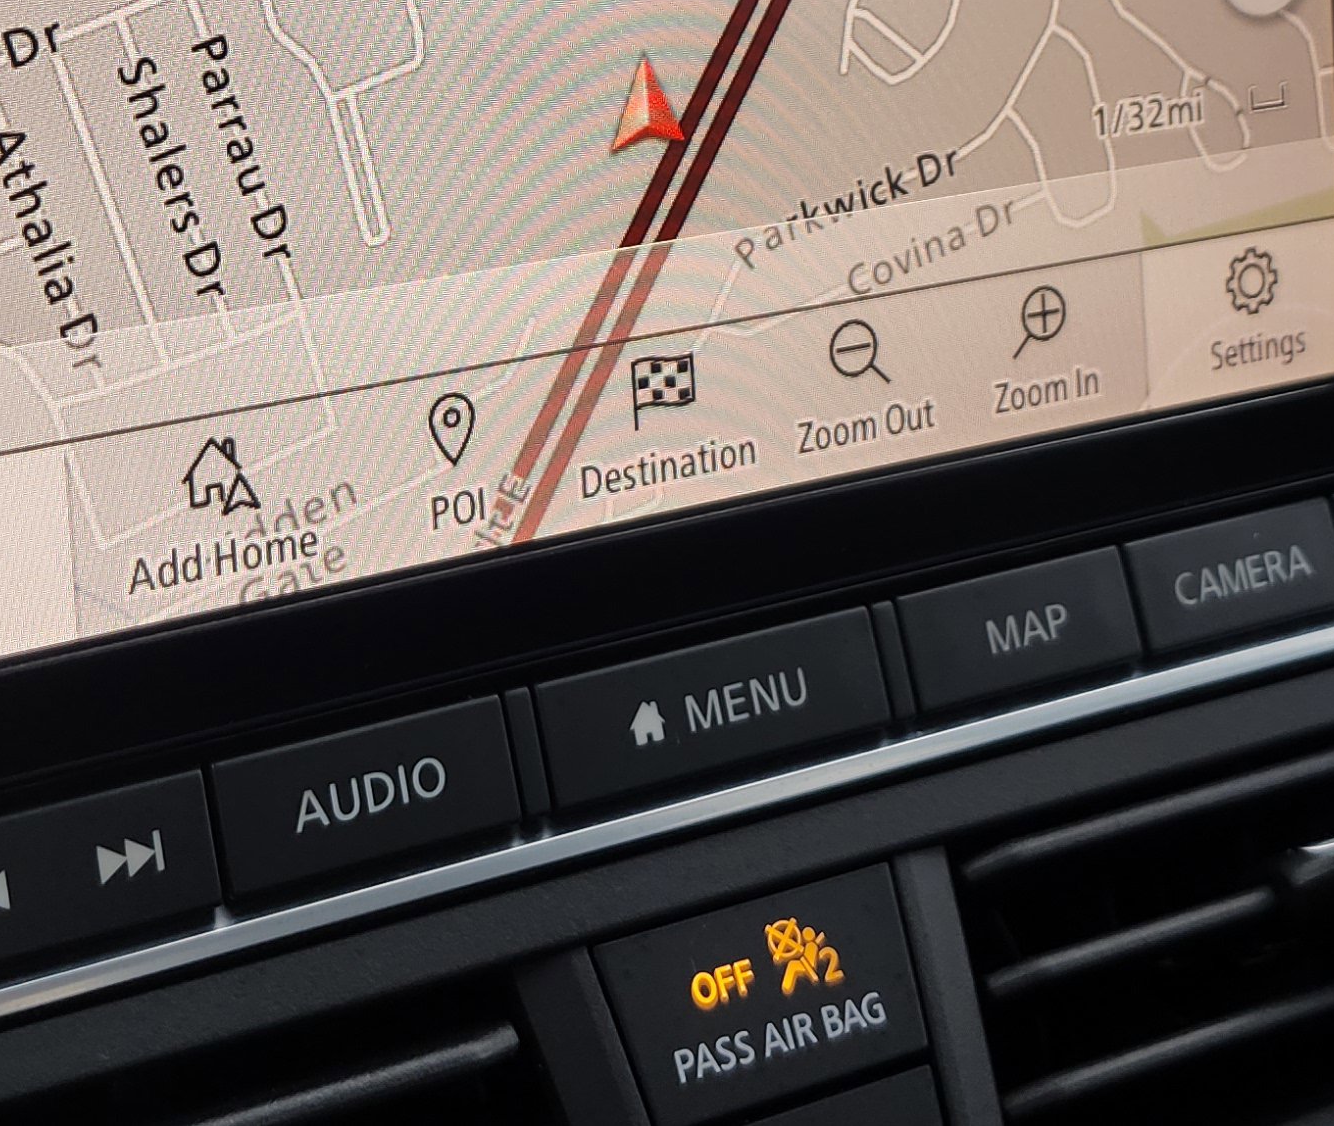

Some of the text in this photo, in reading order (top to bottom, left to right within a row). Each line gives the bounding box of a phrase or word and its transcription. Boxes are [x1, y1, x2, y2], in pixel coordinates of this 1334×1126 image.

[3, 22, 61, 68] Dr
[1092, 90, 1205, 139] 1/32mi
[117, 56, 227, 297] Shalers Dr
[191, 34, 292, 260] Parrau Dr
[734, 147, 959, 270] Parkwick Dr
[847, 195, 1016, 297] Covina Dr
[60, 312, 103, 370] Dr
[1211, 325, 1307, 372] Settings
[994, 369, 1100, 415] Zoom In
[797, 400, 935, 454] Zoom Out
[581, 437, 757, 499] Destination
[430, 487, 487, 531] POI
[129, 530, 319, 595] Add Home
[1174, 544, 1313, 608] CAMERA
[985, 602, 1068, 656] MAP
[684, 666, 809, 733] MENU
[294, 755, 448, 835] AUDIO
[690, 957, 756, 1010] OFF
[673, 989, 888, 1085] PASS AIR BAG
